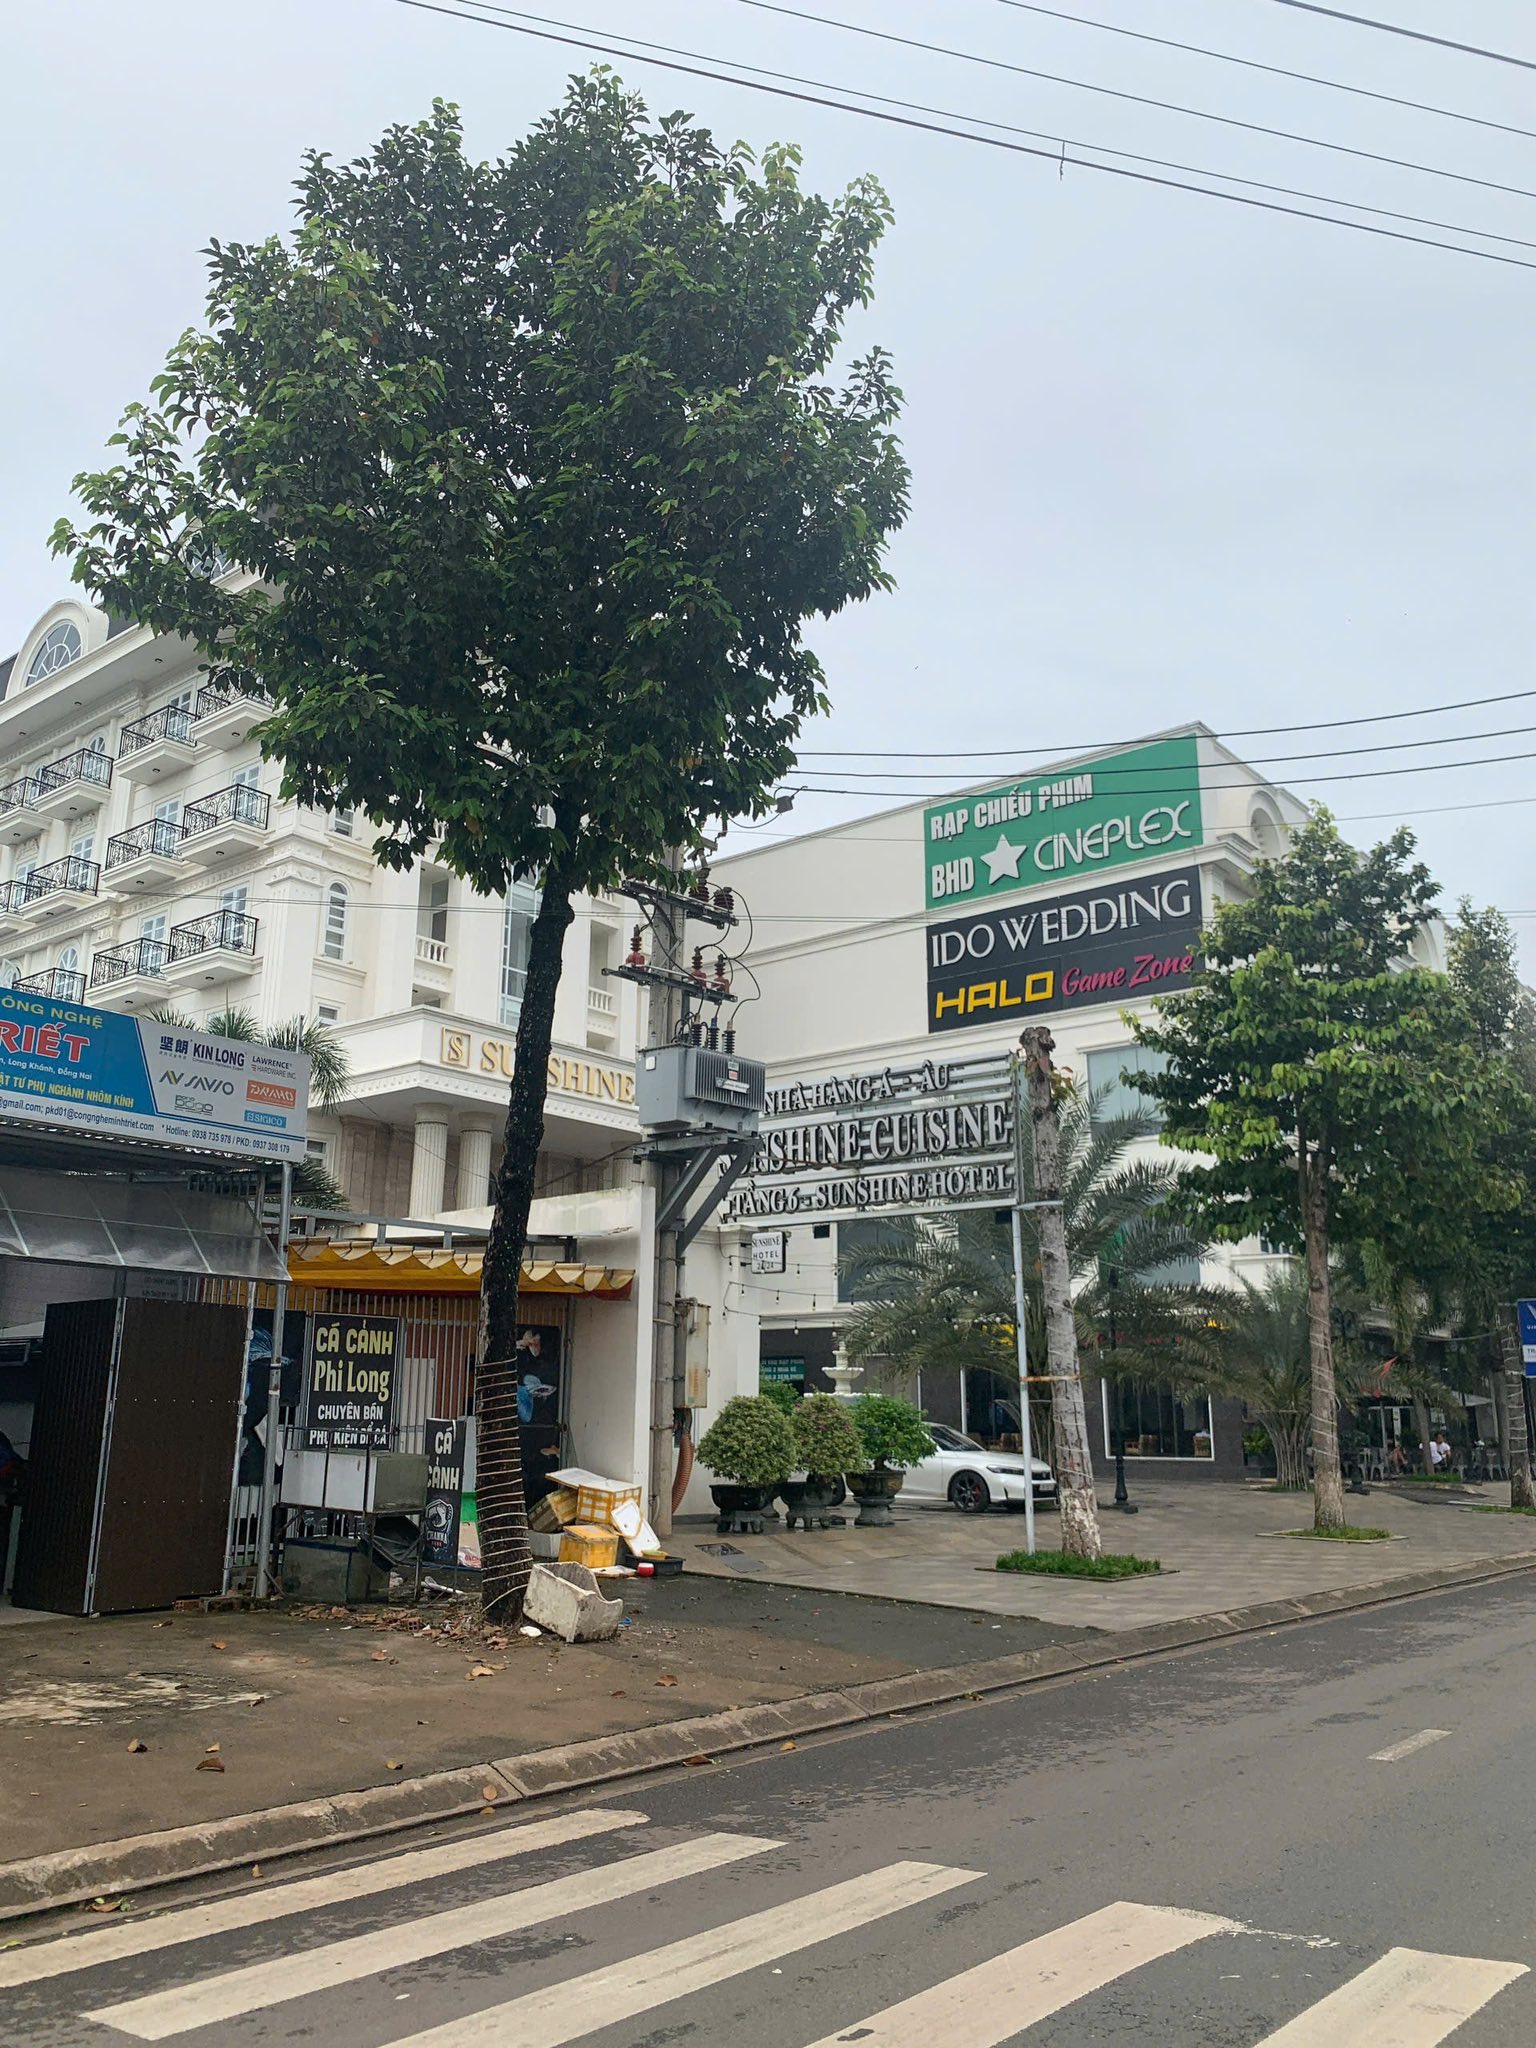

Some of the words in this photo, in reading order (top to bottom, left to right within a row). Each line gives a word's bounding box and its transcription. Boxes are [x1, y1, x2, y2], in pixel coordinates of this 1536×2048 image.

[931, 807, 969, 842] RẠP
[974, 786, 1032, 829] CHIẾU
[1038, 774, 1094, 811] PHIM
[931, 856, 975, 898] BHD
[1033, 800, 1192, 871] CINEPLEX
[931, 924, 996, 967] IDO
[999, 879, 1191, 952] WEDDING
[1062, 966, 1126, 997] Game
[1128, 953, 1194, 988] Zone
[2, 994, 44, 1016] ÔNG
[51, 1007, 103, 1029] NGHỆ
[935, 970, 1056, 1019] HALO
[0, 1020, 90, 1063] RIẾT
[193, 1043, 214, 1060] KIN
[215, 1047, 245, 1067] LONG
[8, 1058, 27, 1070] Long
[29, 1062, 55, 1074] Khánh,
[58, 1066, 77, 1079] Đồng
[79, 1071, 92, 1080] Nai
[252, 1056, 289, 1070] LAWRENCE
[257, 1066, 286, 1078] HARDWARE
[481, 1040, 635, 1104] SUSHINE
[27, 1079, 46, 1094] PHỤ
[86, 1089, 112, 1103] NHÔM
[114, 1093, 134, 1108] KÍNH
[763, 1081, 810, 1115] NHÀ
[812, 1076, 872, 1108] HÀNG
[878, 1067, 895, 1098] Á
[920, 1059, 950, 1093] ÂU
[254, 1114, 283, 1127] SIGICO
[869, 1099, 1011, 1160] CUISINE
[166, 1125, 191, 1138] Hotline:
[192, 1129, 206, 1140] 0938
[208, 1131, 219, 1142] 735
[220, 1133, 232, 1143] 978
[236, 1137, 251, 1148] PKD:
[252, 1140, 267, 1150] 0937
[280, 1144, 290, 1153] 179
[733, 1178, 785, 1215] TẦNG
[788, 1187, 799, 1211] 6
[815, 1174, 929, 1209] SUNSHINE
[930, 1165, 1014, 1197] HOTEL
[753, 1250, 779, 1261] HOTEL
[316, 1322, 340, 1352] CÁ
[346, 1319, 393, 1355] CẢNH
[313, 1359, 343, 1392] Phi
[347, 1361, 390, 1402] Long
[317, 1401, 360, 1420] CHUYÊN
[363, 1402, 384, 1420] BÁN
[435, 1427, 453, 1455] CÁ
[427, 1456, 460, 1490] CẢNH
